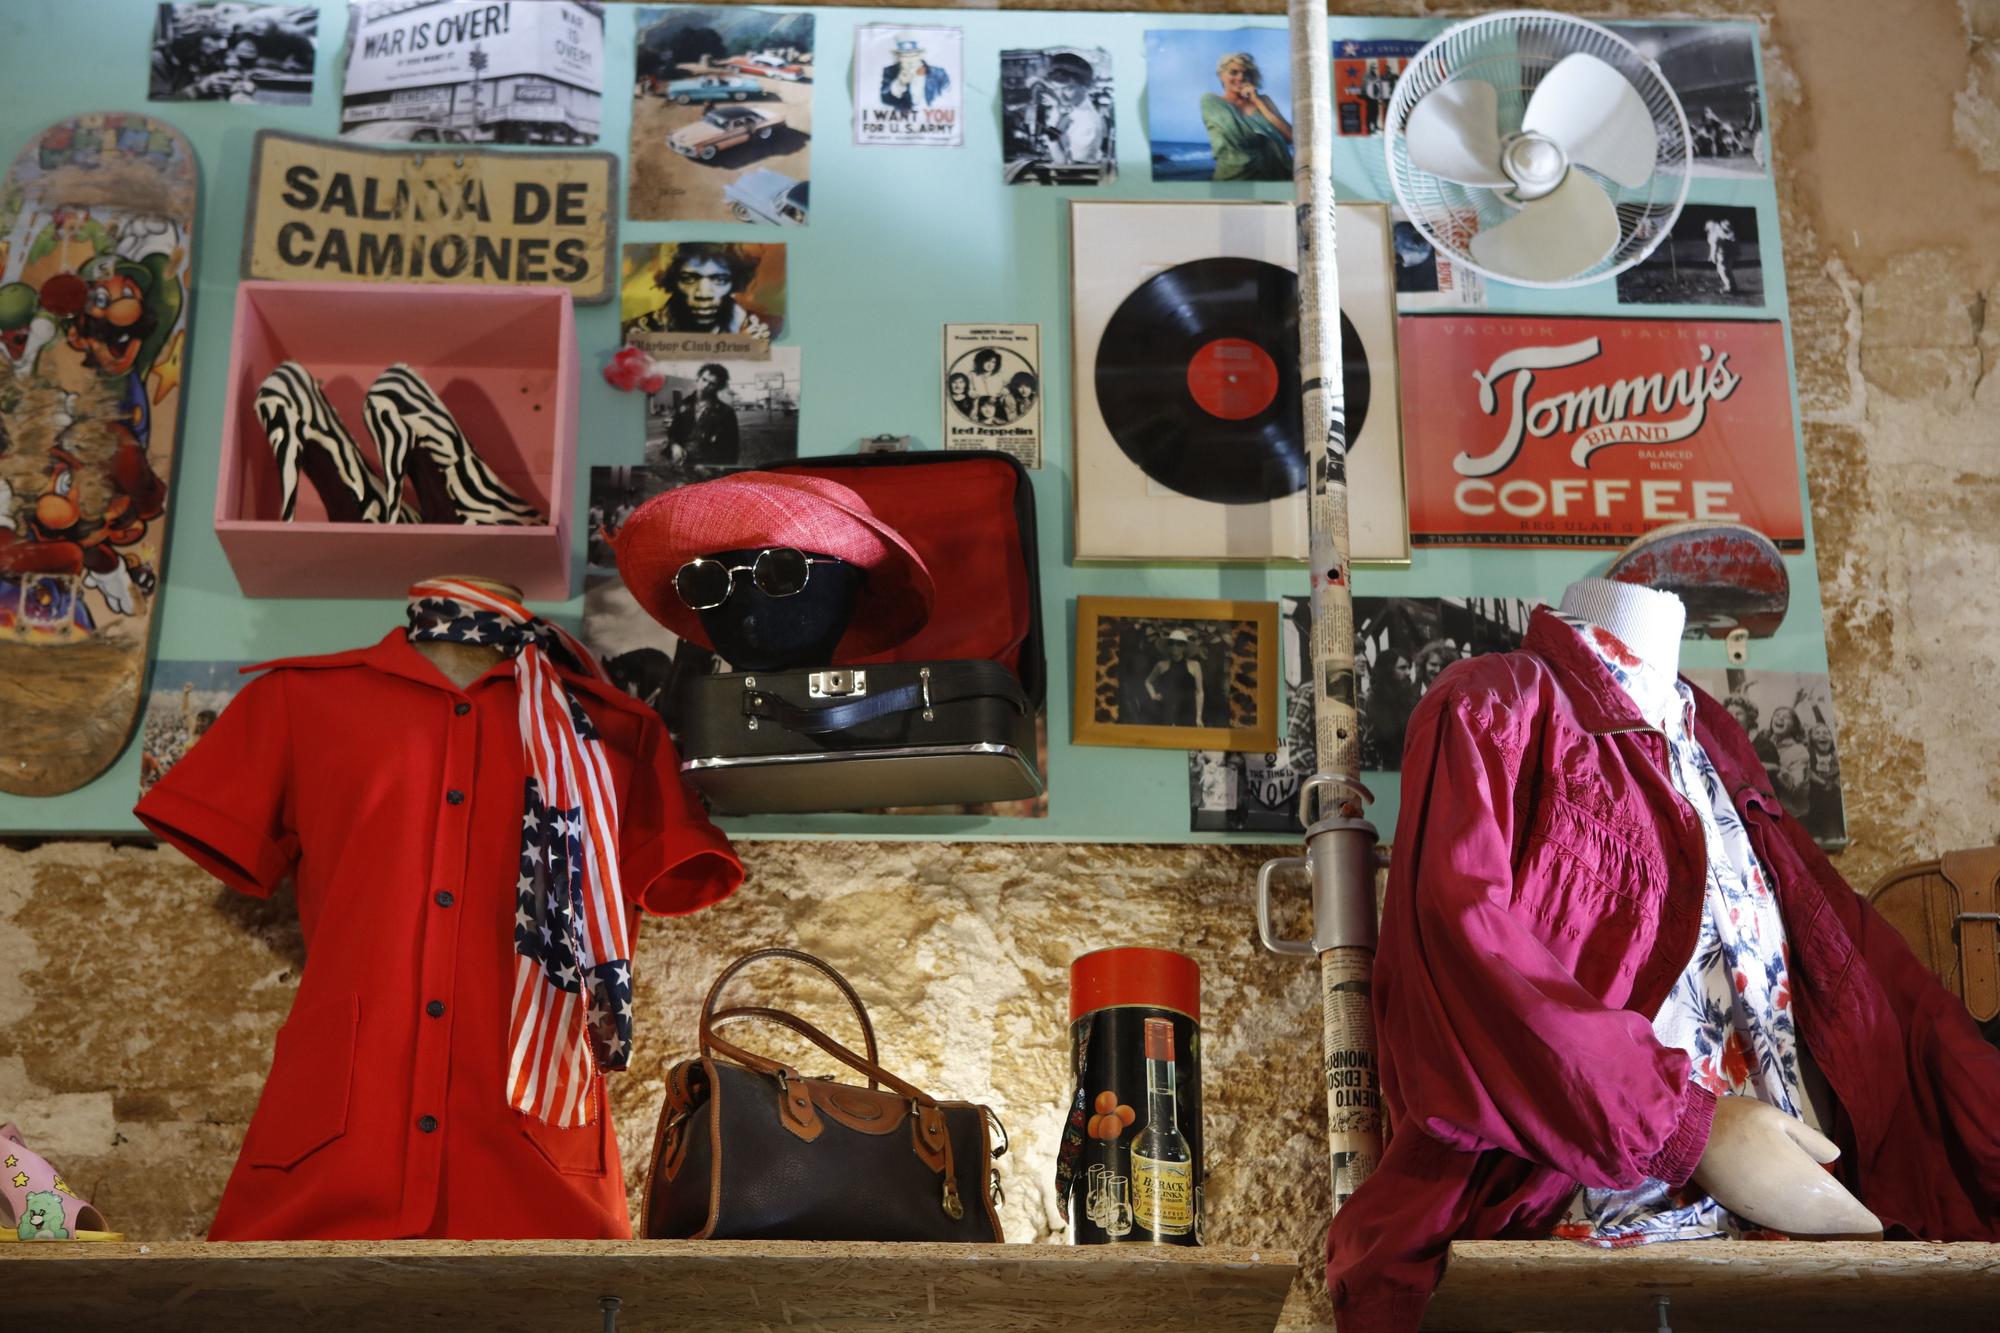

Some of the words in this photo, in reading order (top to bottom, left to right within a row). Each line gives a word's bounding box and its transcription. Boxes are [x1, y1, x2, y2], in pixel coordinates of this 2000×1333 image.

[364, 28, 404, 59] WAR
[409, 22, 431, 52] IS
[435, 2, 510, 46] OVER!
[863, 110, 867, 122] I
[873, 110, 918, 122] WANT
[923, 109, 956, 123] YOU
[863, 123, 885, 133] FOR
[919, 124, 954, 134] ARMY
[513, 182, 589, 226] DE
[277, 221, 590, 282] CAMIONES
[1443, 325, 1556, 337] VACUUM
[1620, 328, 1728, 340] PACKED
[682, 339, 711, 351] Club
[711, 340, 751, 353] News
[1453, 336, 1743, 477] Tommy's
[952, 427, 974, 435] Led
[977, 427, 1033, 436] Zeppelin
[1585, 425, 1669, 447] BRAND
[1638, 450, 1694, 460] BALANCED
[1650, 460, 1684, 471] BLEND
[1454, 478, 1741, 522] COFFEE
[1267, 769, 1284, 779] TIME
[1250, 779, 1294, 805] NOW
[1336, 1089, 1376, 1108] IENTO
[1143, 1176, 1185, 1192] BRACK
[1145, 1187, 1184, 1199] PINKA
